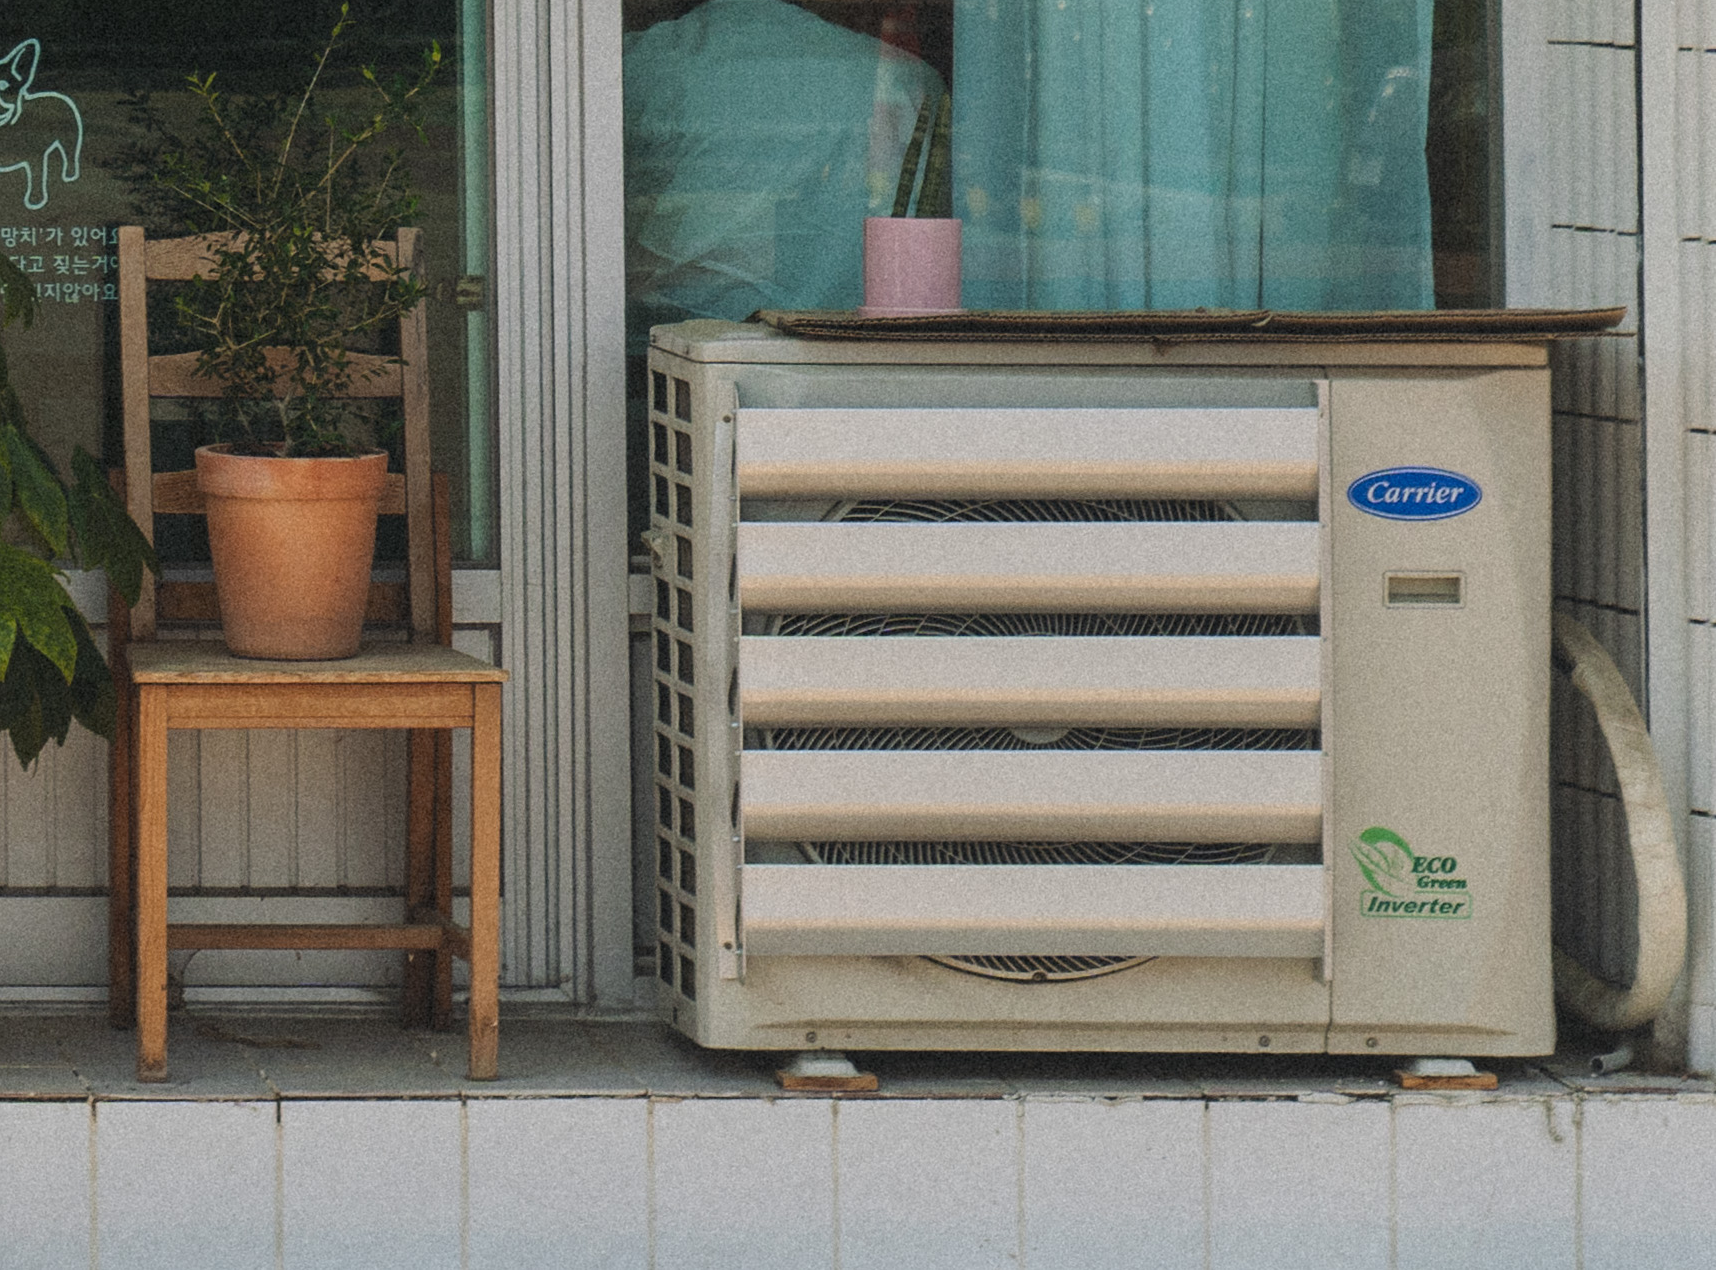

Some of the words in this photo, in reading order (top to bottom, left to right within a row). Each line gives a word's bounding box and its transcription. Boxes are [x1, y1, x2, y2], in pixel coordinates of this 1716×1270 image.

[1366, 480, 1465, 504] Carrier
[1411, 855, 1458, 874] ECO
[1417, 875, 1467, 890] Green
[1367, 896, 1466, 915] Inverter
